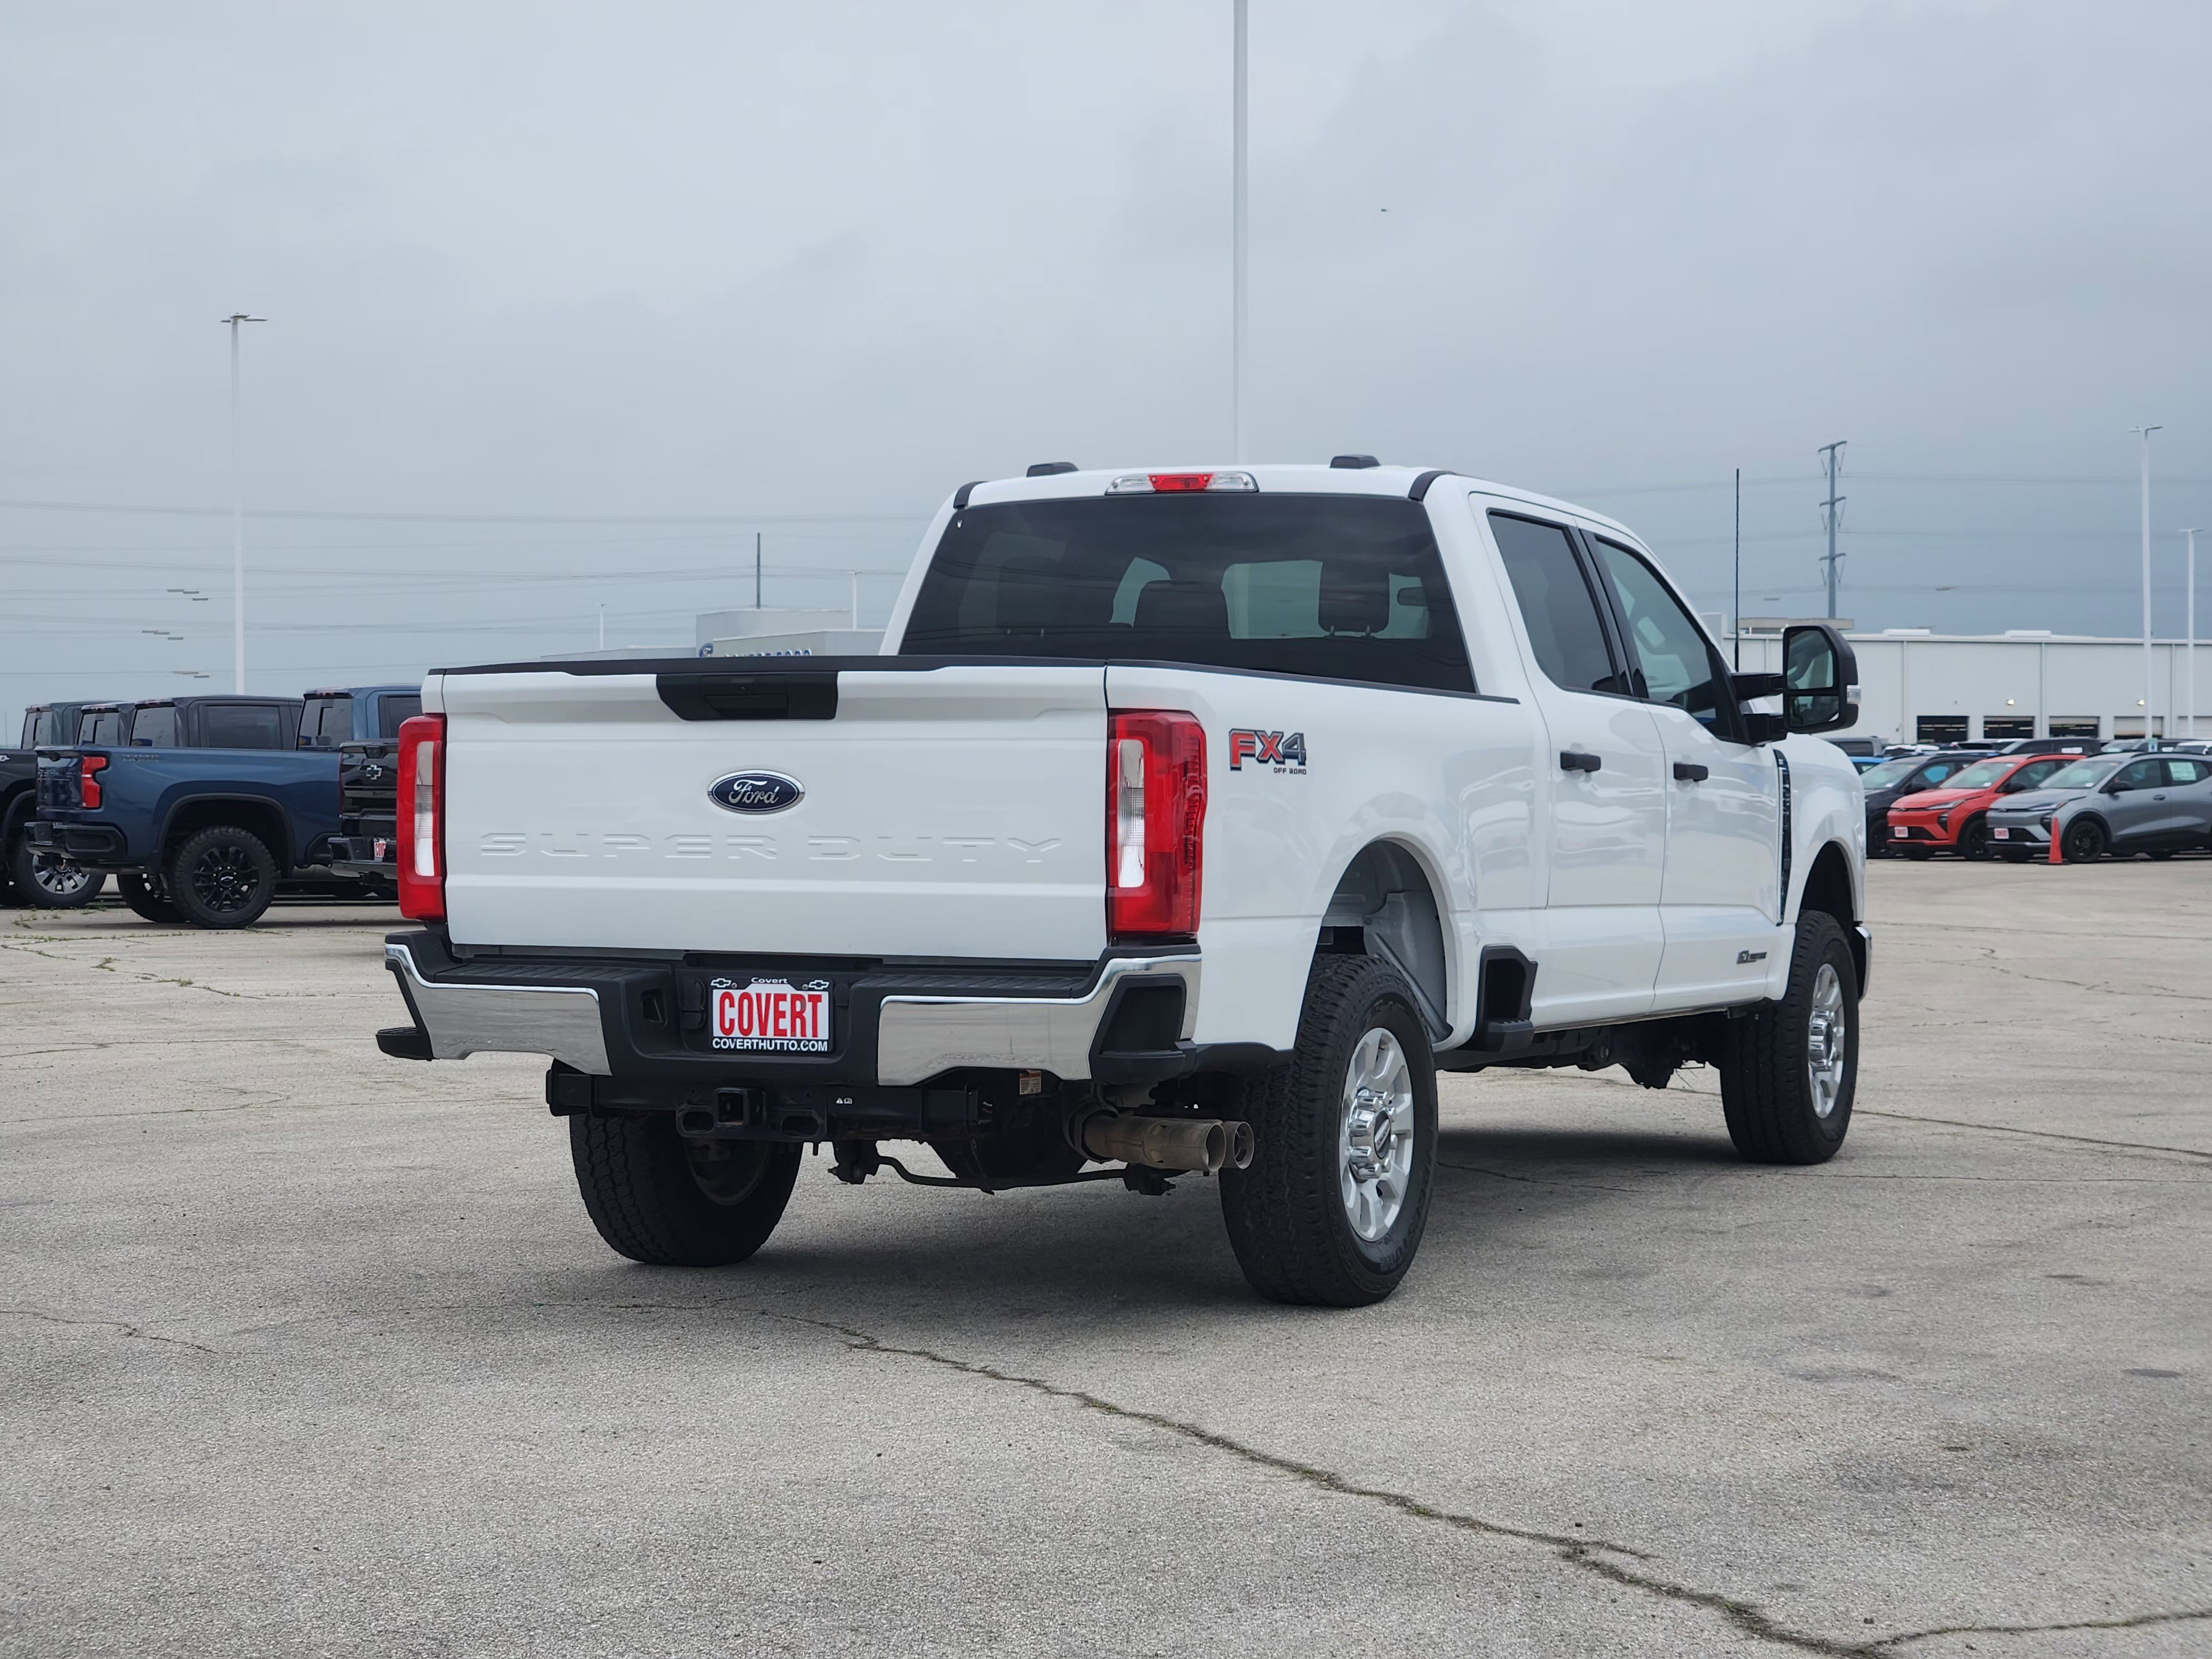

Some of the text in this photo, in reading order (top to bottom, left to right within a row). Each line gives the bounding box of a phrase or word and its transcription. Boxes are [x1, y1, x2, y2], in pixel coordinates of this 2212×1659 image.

[1228, 728, 1306, 771] FX4
[728, 779, 780, 804] Ford
[481, 833, 1061, 863] SUPER DUTY
[719, 991, 822, 1038] COVERT
[712, 1038, 828, 1051] COVERTHUTTO.COM
